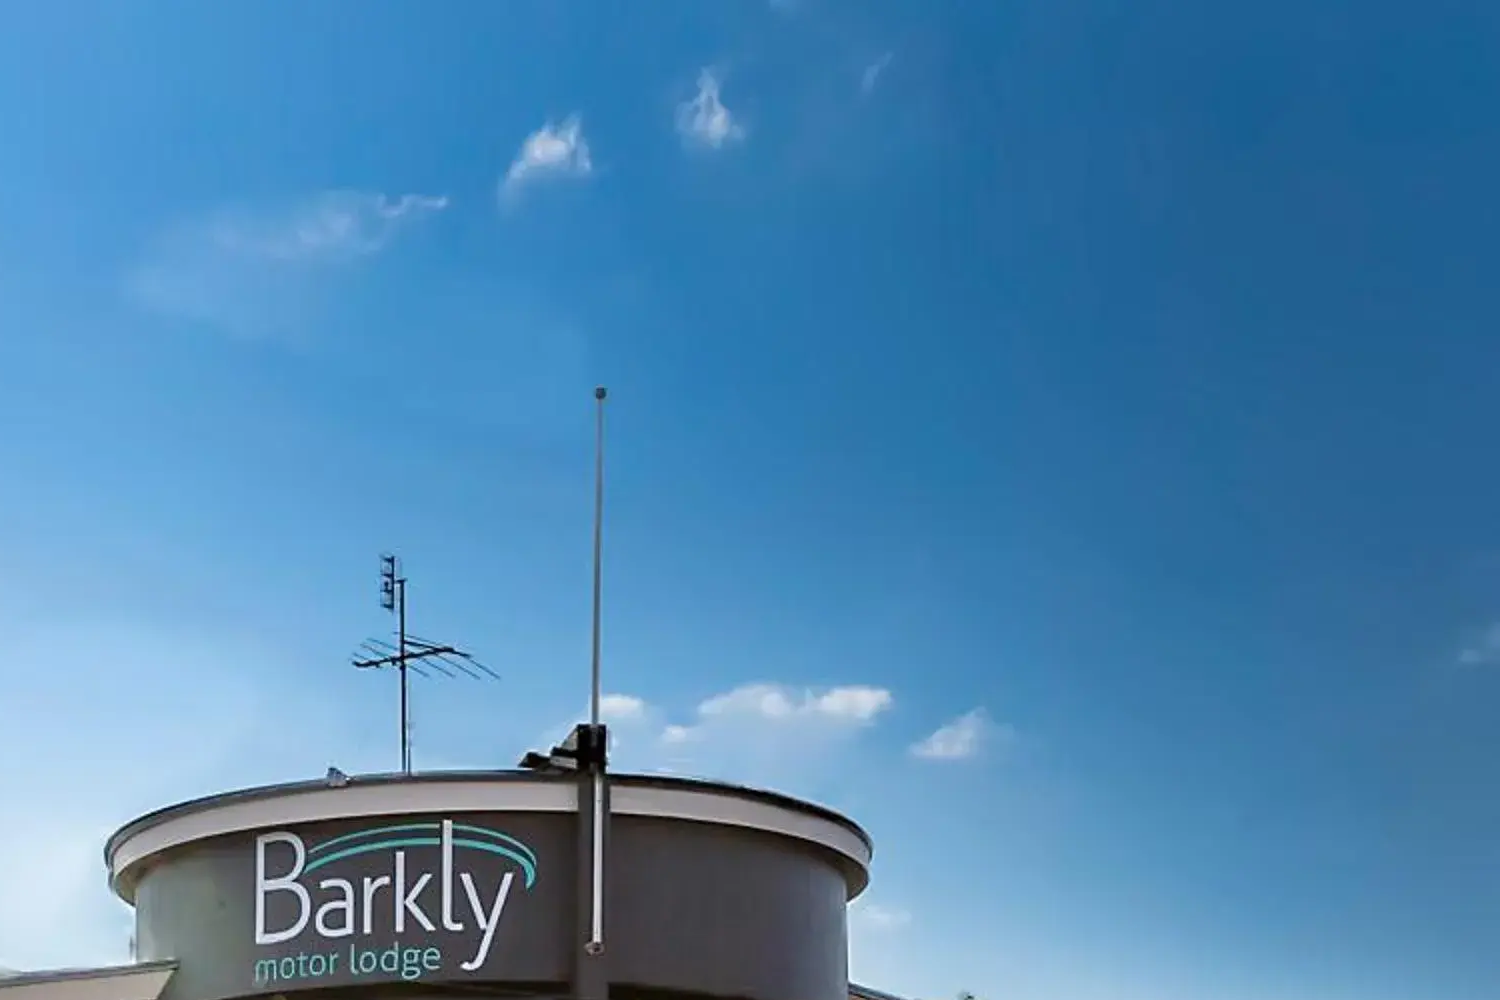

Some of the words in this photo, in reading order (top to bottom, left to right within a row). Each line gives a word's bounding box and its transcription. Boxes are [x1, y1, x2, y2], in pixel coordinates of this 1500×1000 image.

[255, 819, 514, 971] Barkly
[255, 949, 340, 983] motor
[349, 941, 442, 980] lodge
